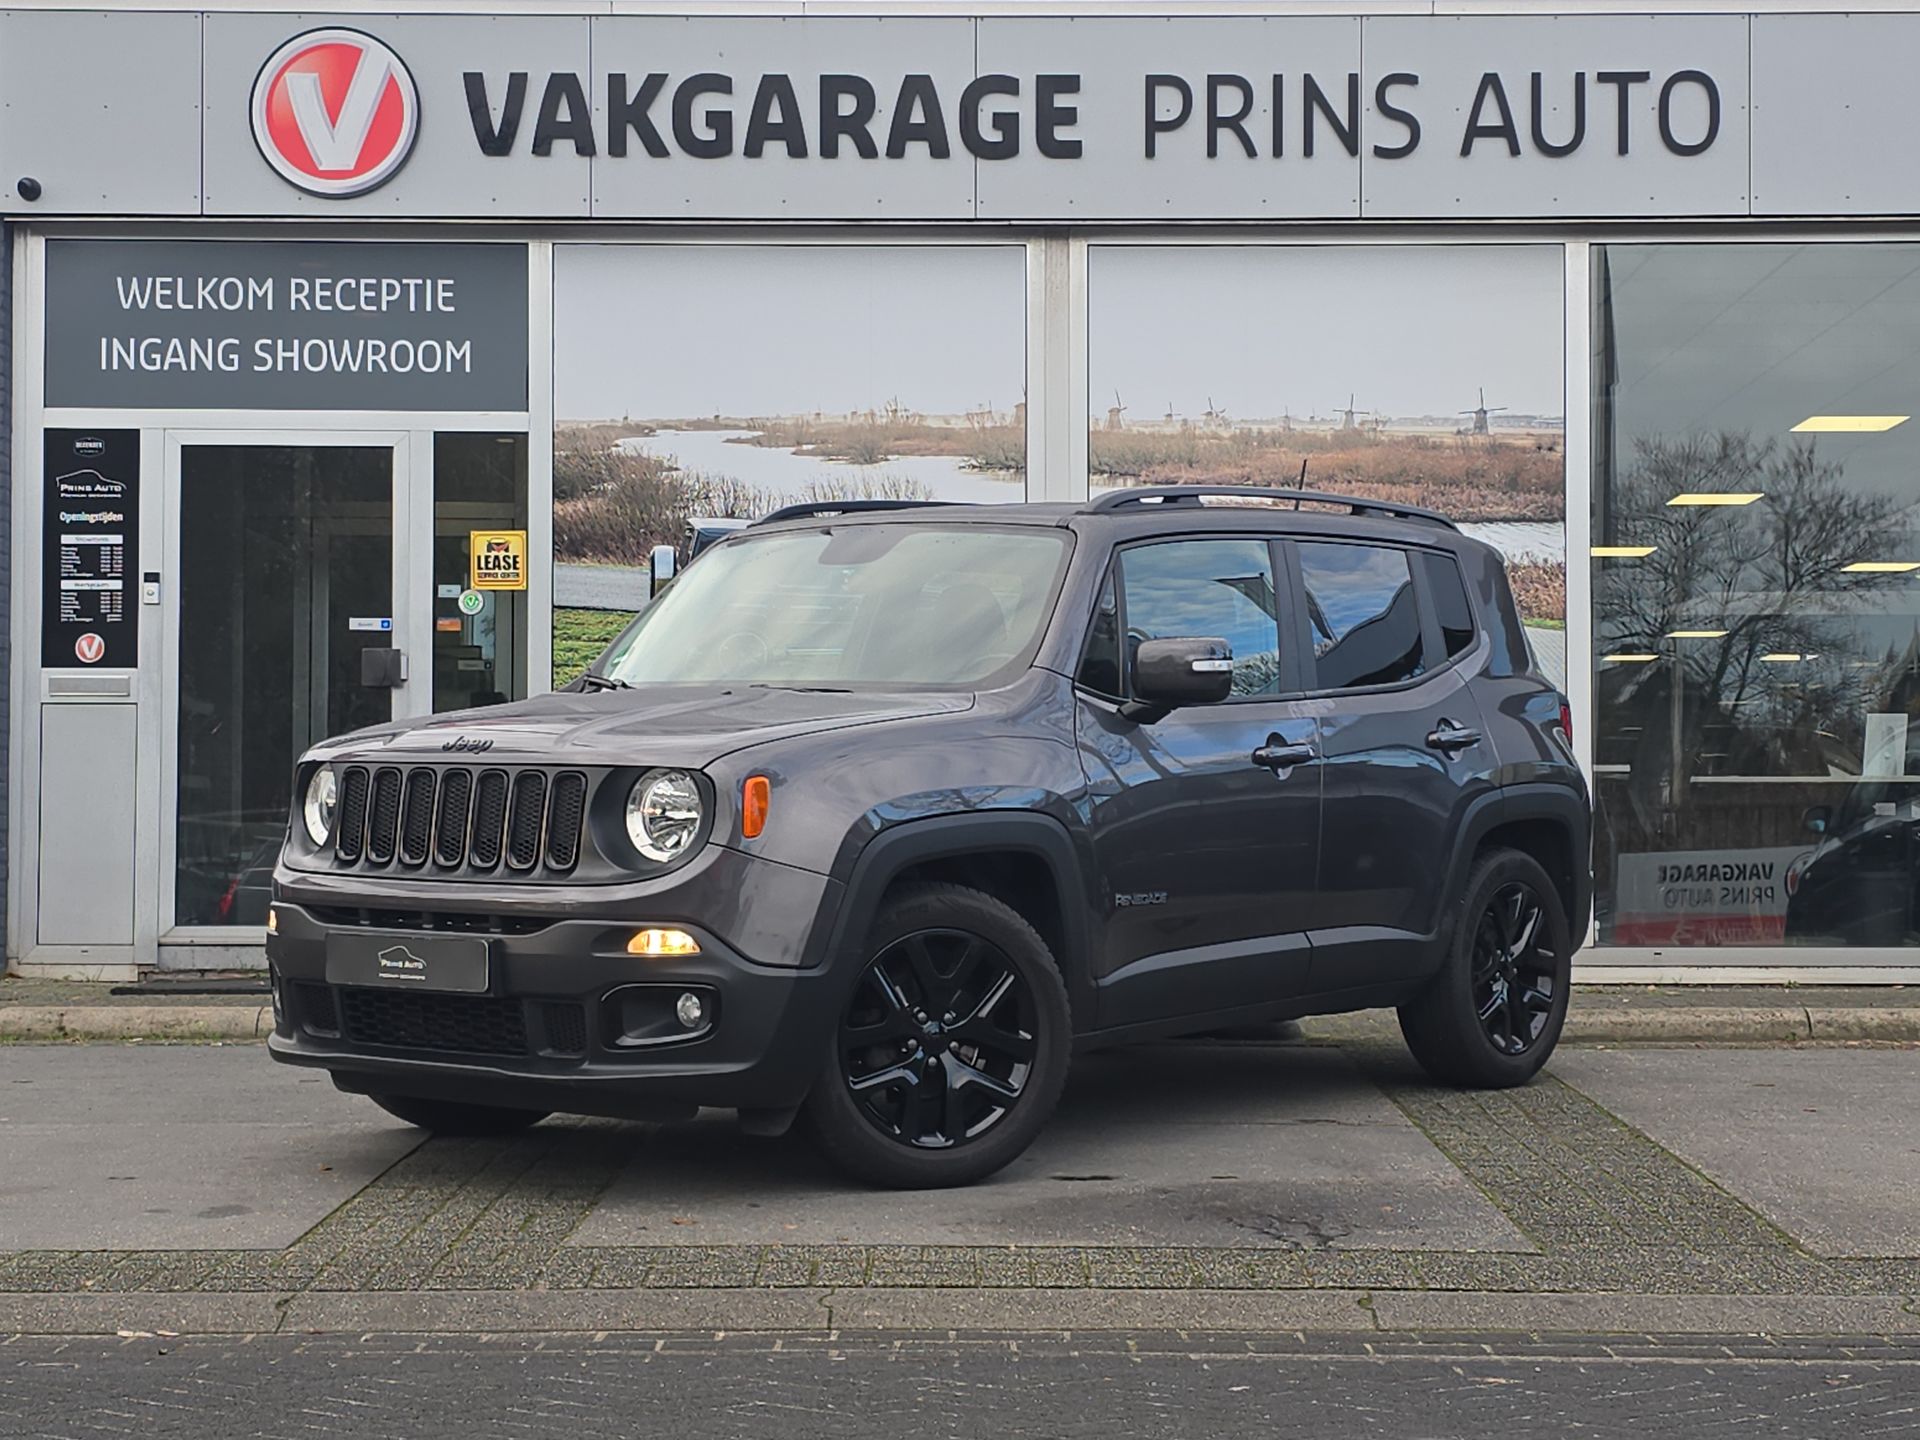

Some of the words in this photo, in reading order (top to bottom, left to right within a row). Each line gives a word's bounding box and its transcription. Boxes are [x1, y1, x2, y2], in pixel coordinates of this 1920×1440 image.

[463, 72, 1083, 160] VAKGARAGE
[1144, 73, 1421, 159] PRINS
[1459, 69, 1721, 158] AUTO
[116, 276, 273, 311] WELKOM
[290, 277, 456, 312] RECEPTIE
[101, 337, 240, 372] INGANG
[253, 338, 471, 373] SHOWROOM
[476, 554, 520, 571] LEASE
[442, 735, 495, 755] Jeep
